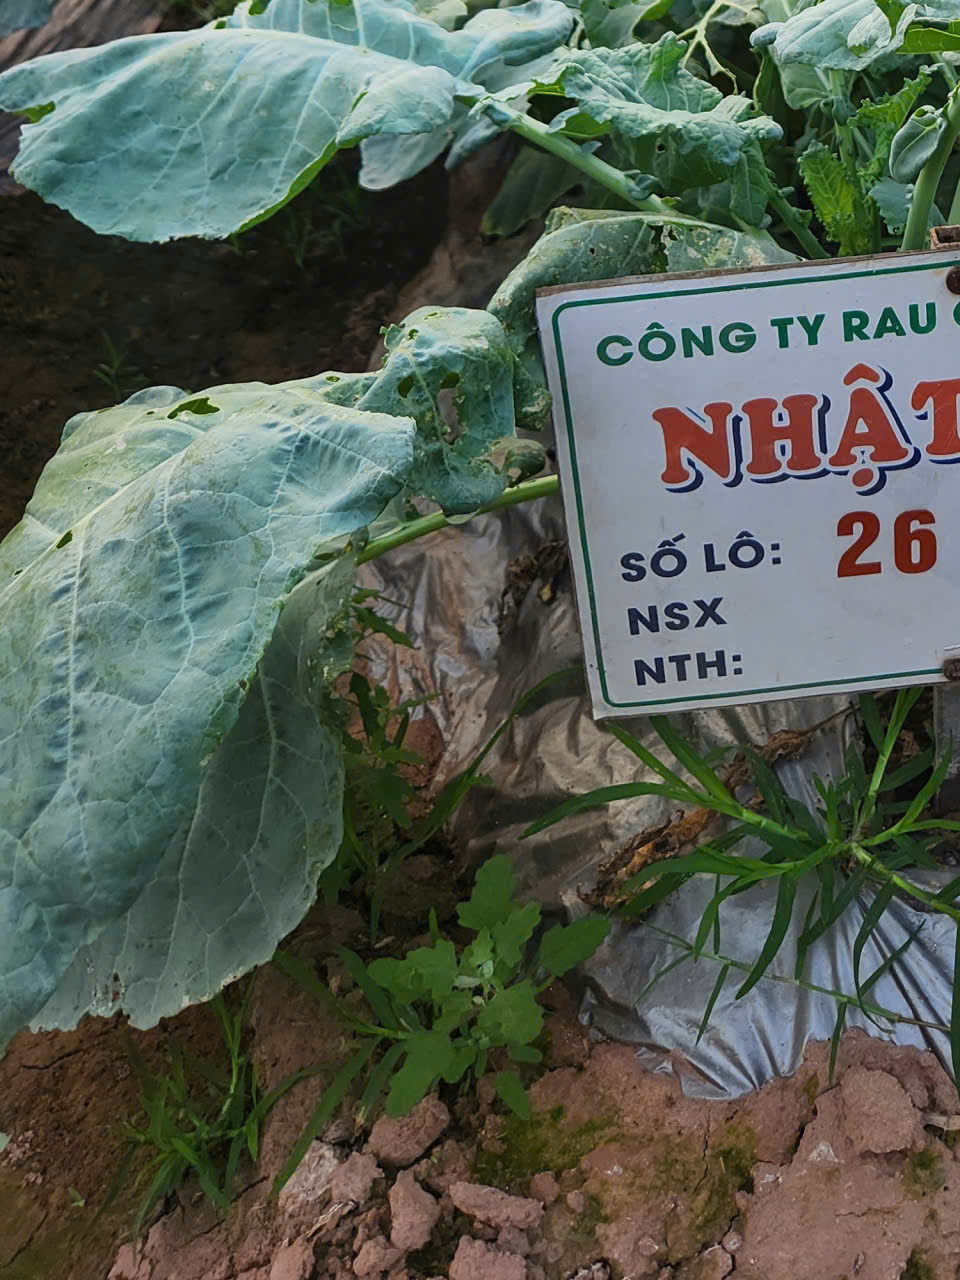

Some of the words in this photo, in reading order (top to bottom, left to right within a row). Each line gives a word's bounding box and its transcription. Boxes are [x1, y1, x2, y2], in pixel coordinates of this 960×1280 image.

[596, 321, 757, 366] CÔNG
[770, 314, 826, 349] TY
[842, 301, 938, 342] RAU
[620, 532, 688, 582] SỐ
[703, 530, 782, 573] LÔ:
[836, 508, 938, 578] 26
[627, 596, 728, 636] NSX
[633, 649, 744, 686] NTH:
